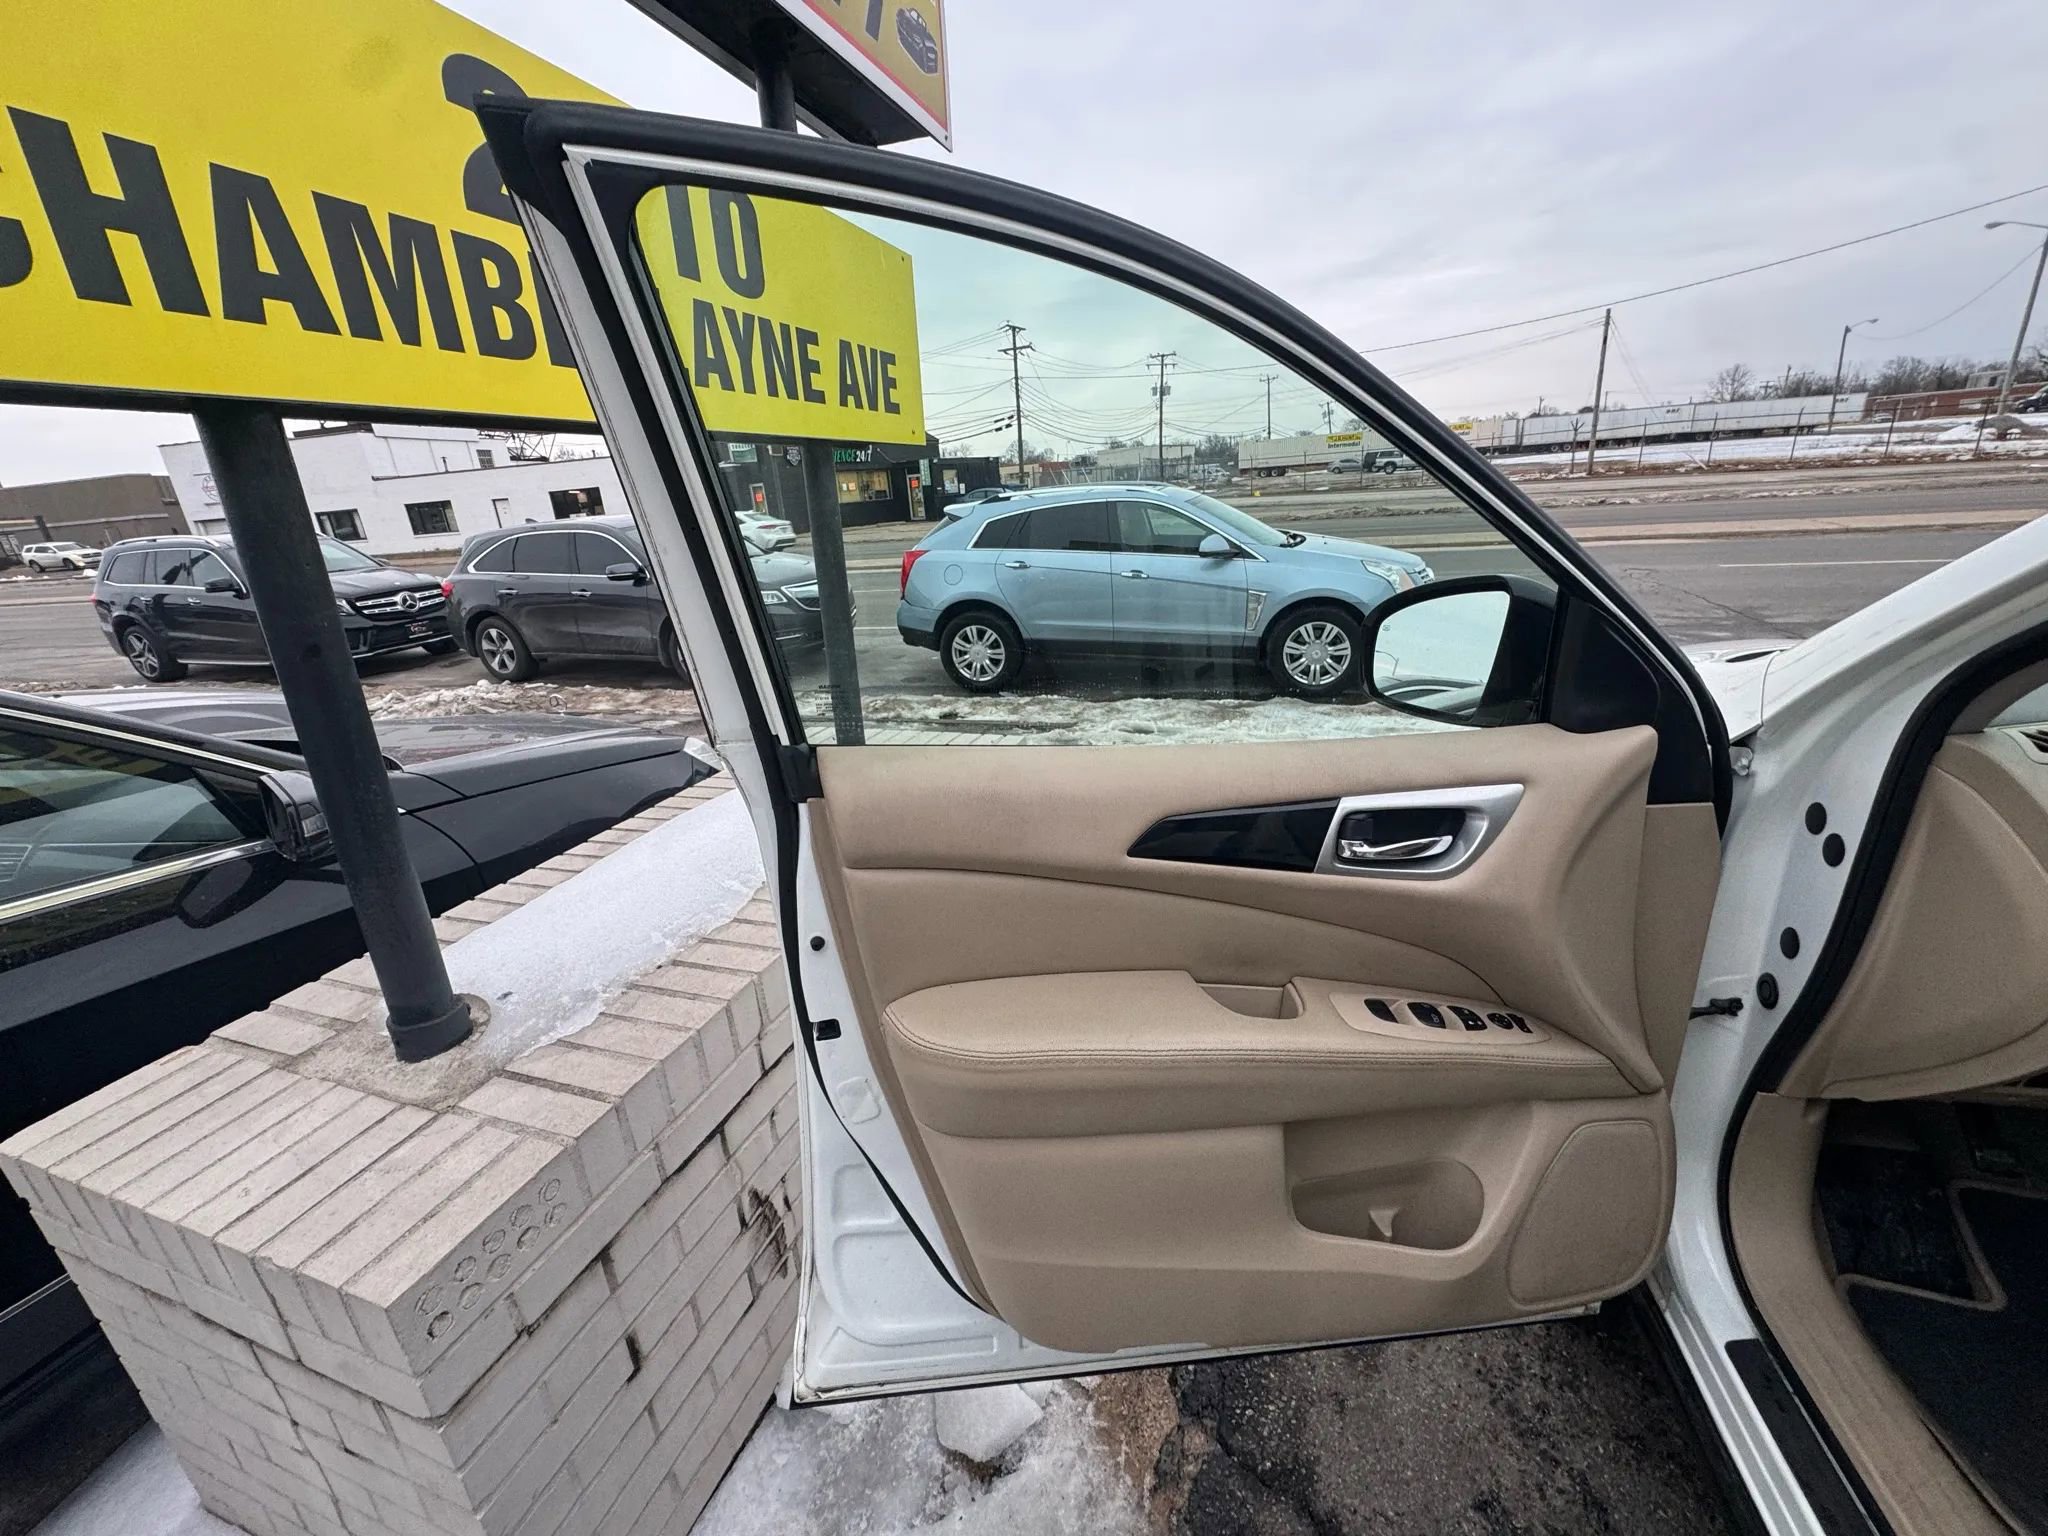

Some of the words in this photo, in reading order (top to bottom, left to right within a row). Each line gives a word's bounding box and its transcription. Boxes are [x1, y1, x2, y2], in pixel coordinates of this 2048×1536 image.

[0, 106, 578, 368] HAMB
[838, 339, 901, 415] AVE
[855, 450, 871, 462] 24/7
